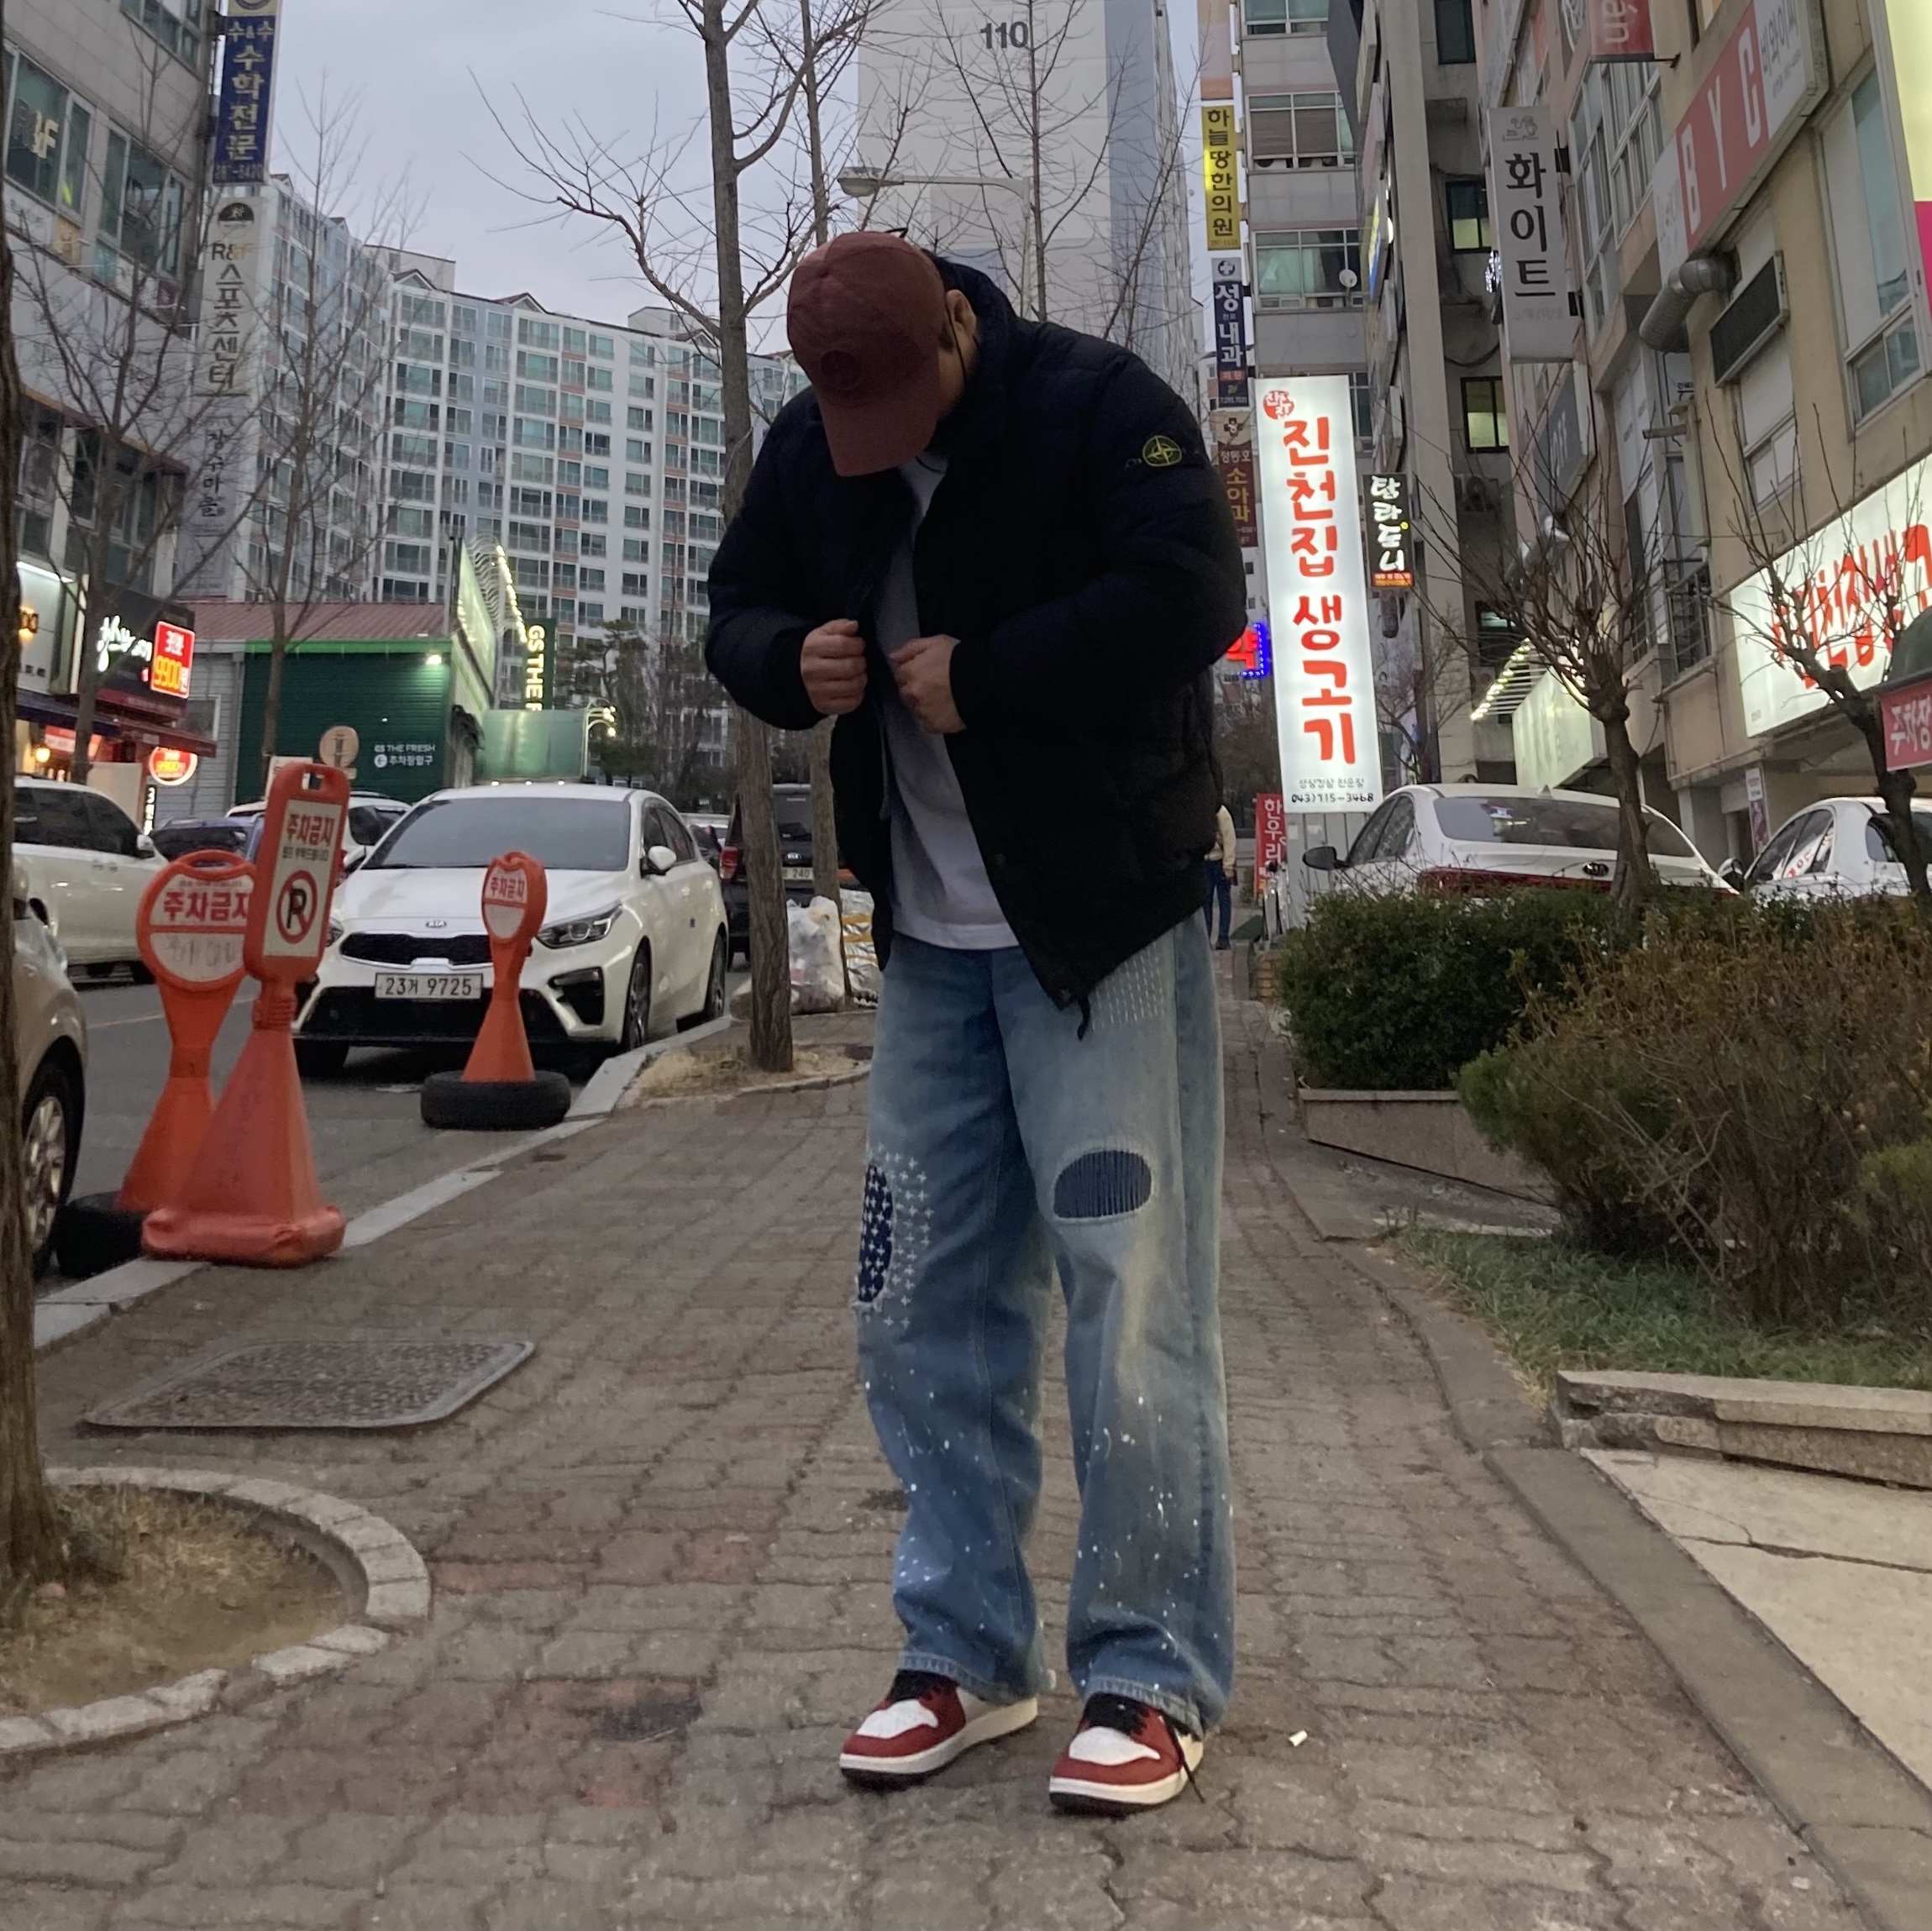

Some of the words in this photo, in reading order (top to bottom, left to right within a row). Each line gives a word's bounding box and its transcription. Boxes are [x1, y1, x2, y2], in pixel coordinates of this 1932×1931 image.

[980, 21, 1029, 50] 110
[1681, 27, 1761, 235] BYC
[1207, 108, 1233, 237] 하늘땅한의원
[1504, 151, 1557, 297] 화이트
[208, 263, 244, 390] 스포츠센터
[1226, 467, 1250, 522] 소아과
[1283, 416, 1339, 578] 진천집
[528, 625, 545, 651] GS
[526, 653, 544, 698] THE
[1293, 594, 1357, 765] 생고기
[387, 744, 405, 753] THE
[405, 743, 436, 753] FRESH
[286, 812, 335, 847] 주차금지
[164, 890, 251, 922] 주차금지
[491, 876, 525, 899] 주차금지
[428, 977, 472, 996] 9725
